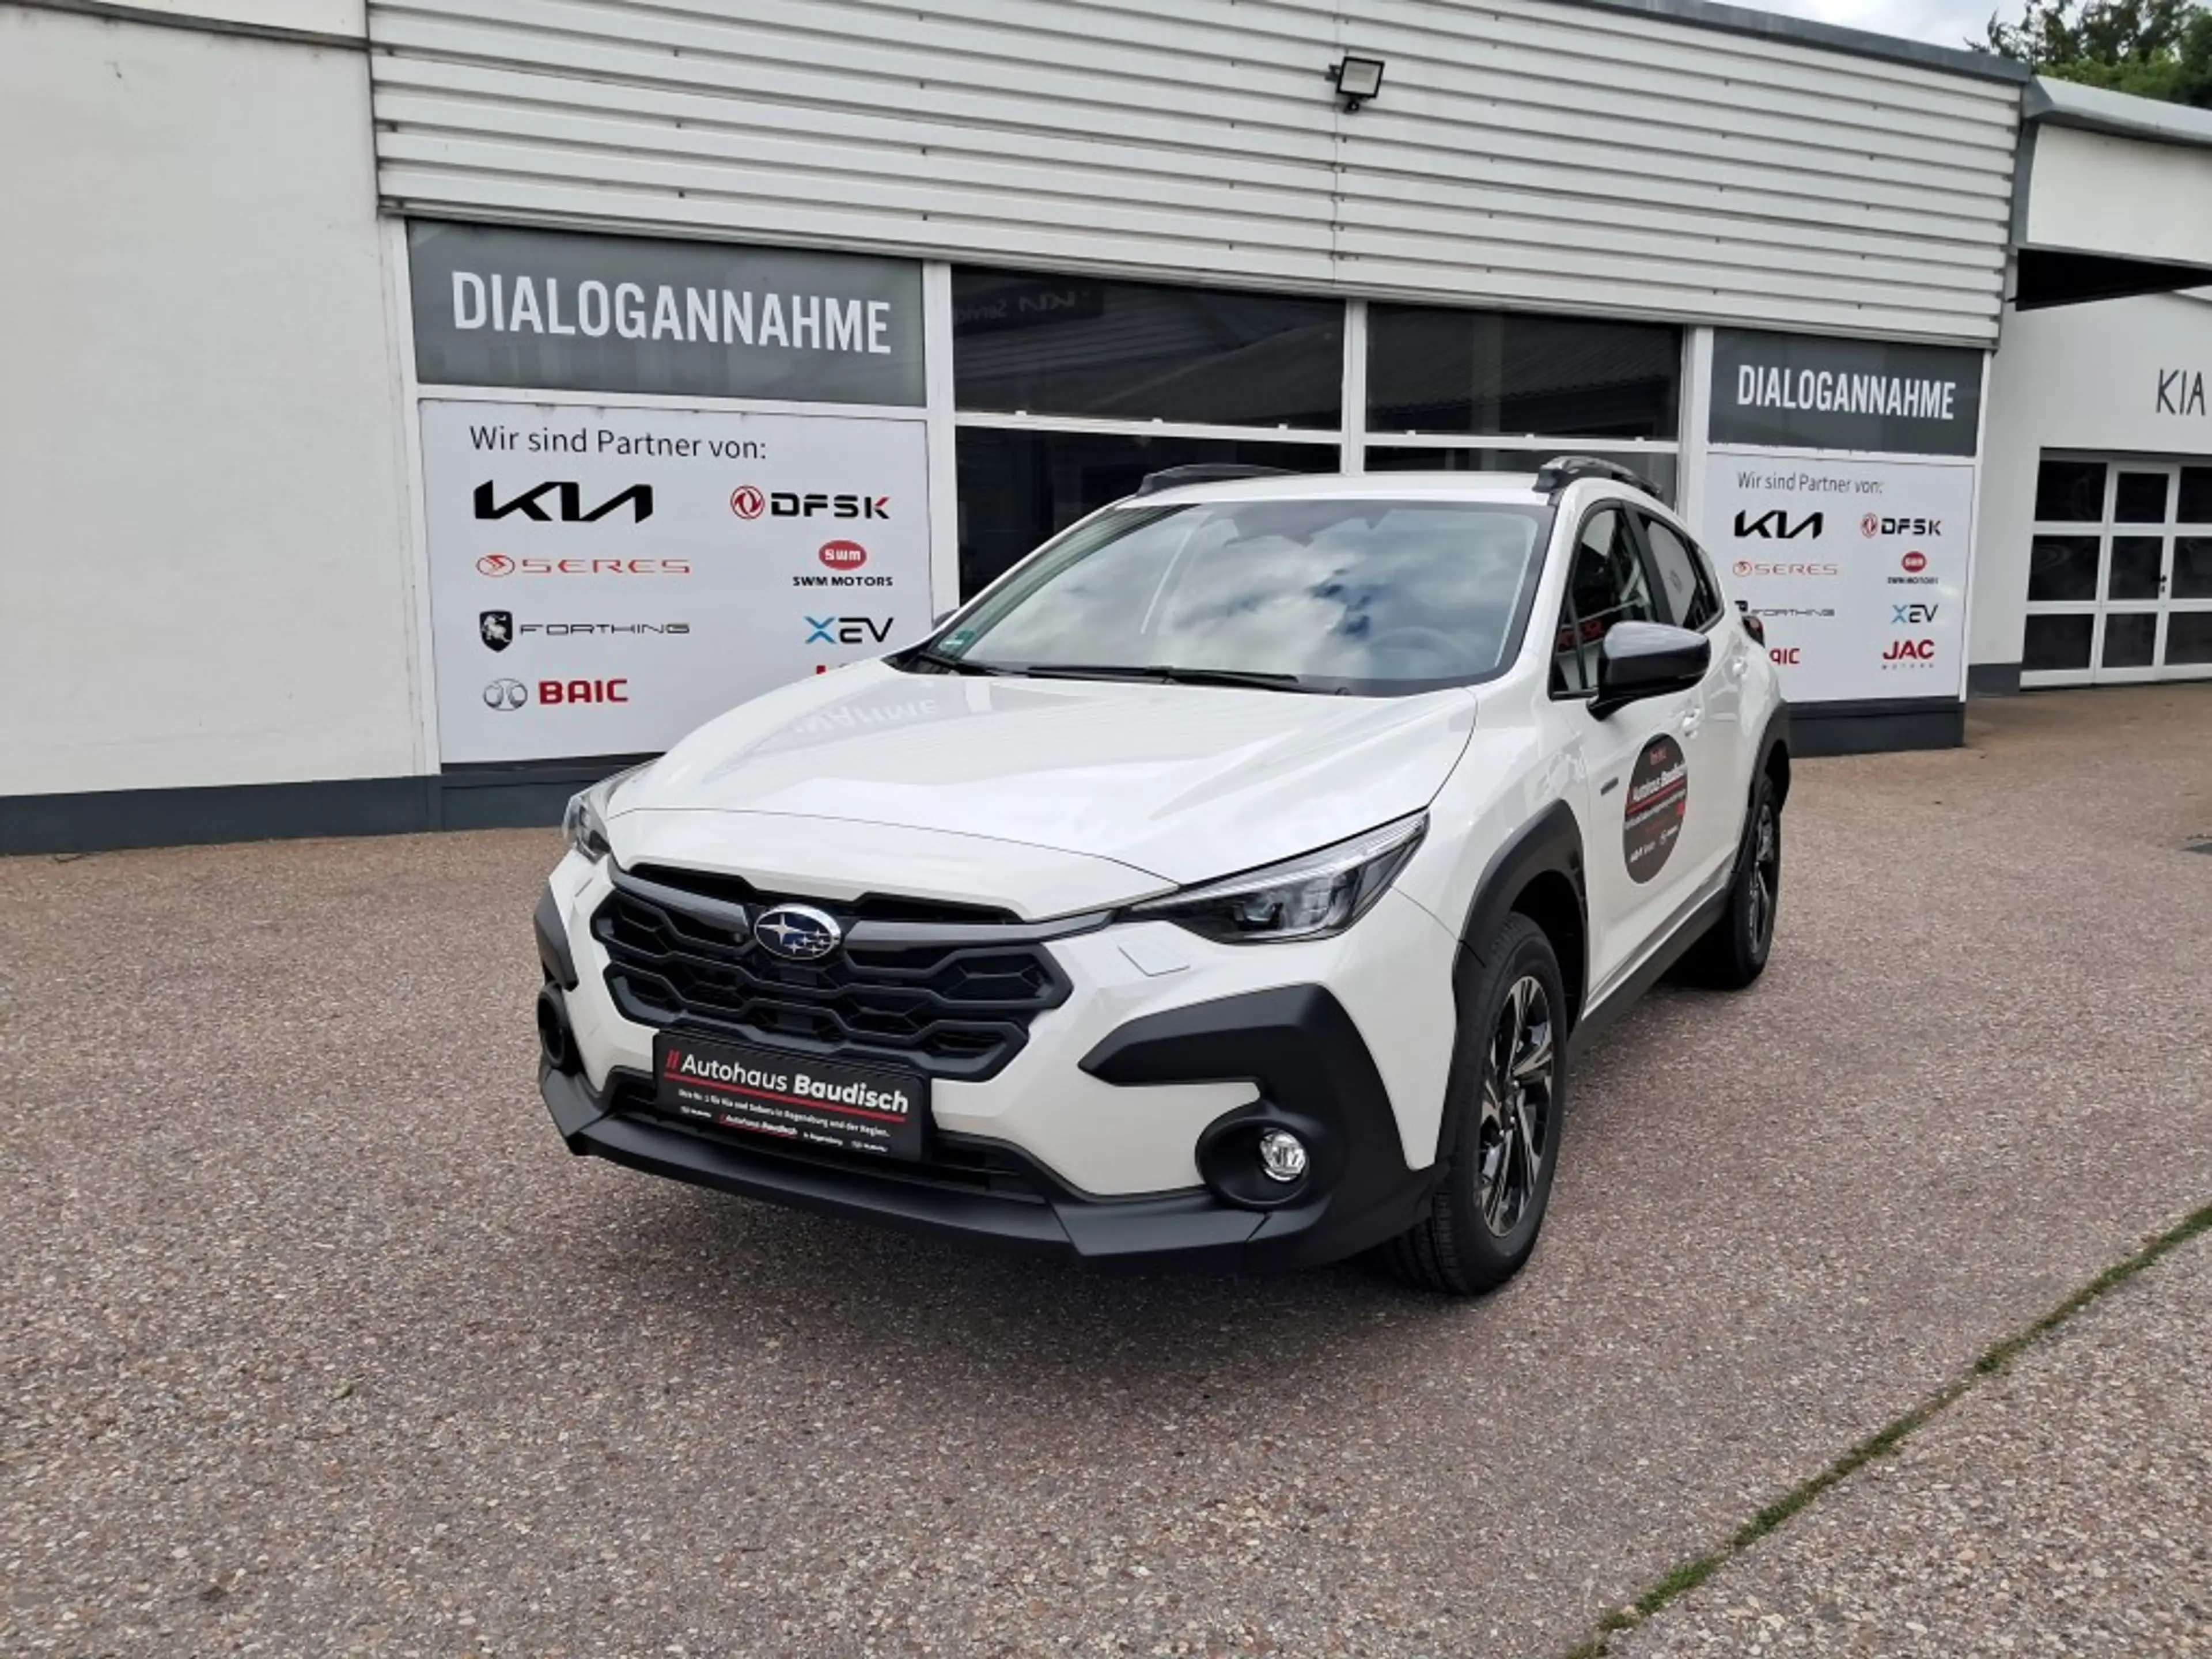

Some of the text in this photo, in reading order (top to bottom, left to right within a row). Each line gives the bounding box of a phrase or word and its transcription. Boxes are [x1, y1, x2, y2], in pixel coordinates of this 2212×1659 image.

[452, 270, 891, 354] DIALOGANNAHME
[1737, 365, 1956, 419] DIALOGANNAHME
[2156, 368, 2206, 416] KIA
[470, 425, 767, 459] Wir sind Partner von:
[1737, 471, 1883, 494] Wir sind Partner von:
[771, 491, 890, 520] DFSK
[1881, 518, 1942, 536] DFSK
[521, 559, 691, 574] SERES
[1755, 563, 1838, 575] SERES
[793, 577, 893, 586] SWM MOTORS
[1891, 604, 1939, 624] XEV
[520, 624, 691, 635] FORTHING
[804, 616, 895, 644] XEV
[1768, 647, 1801, 665] AIC
[1883, 639, 1934, 660] JAC
[538, 678, 630, 705] BAIC
[681, 1054, 909, 1114] Autohaus Baudisch
